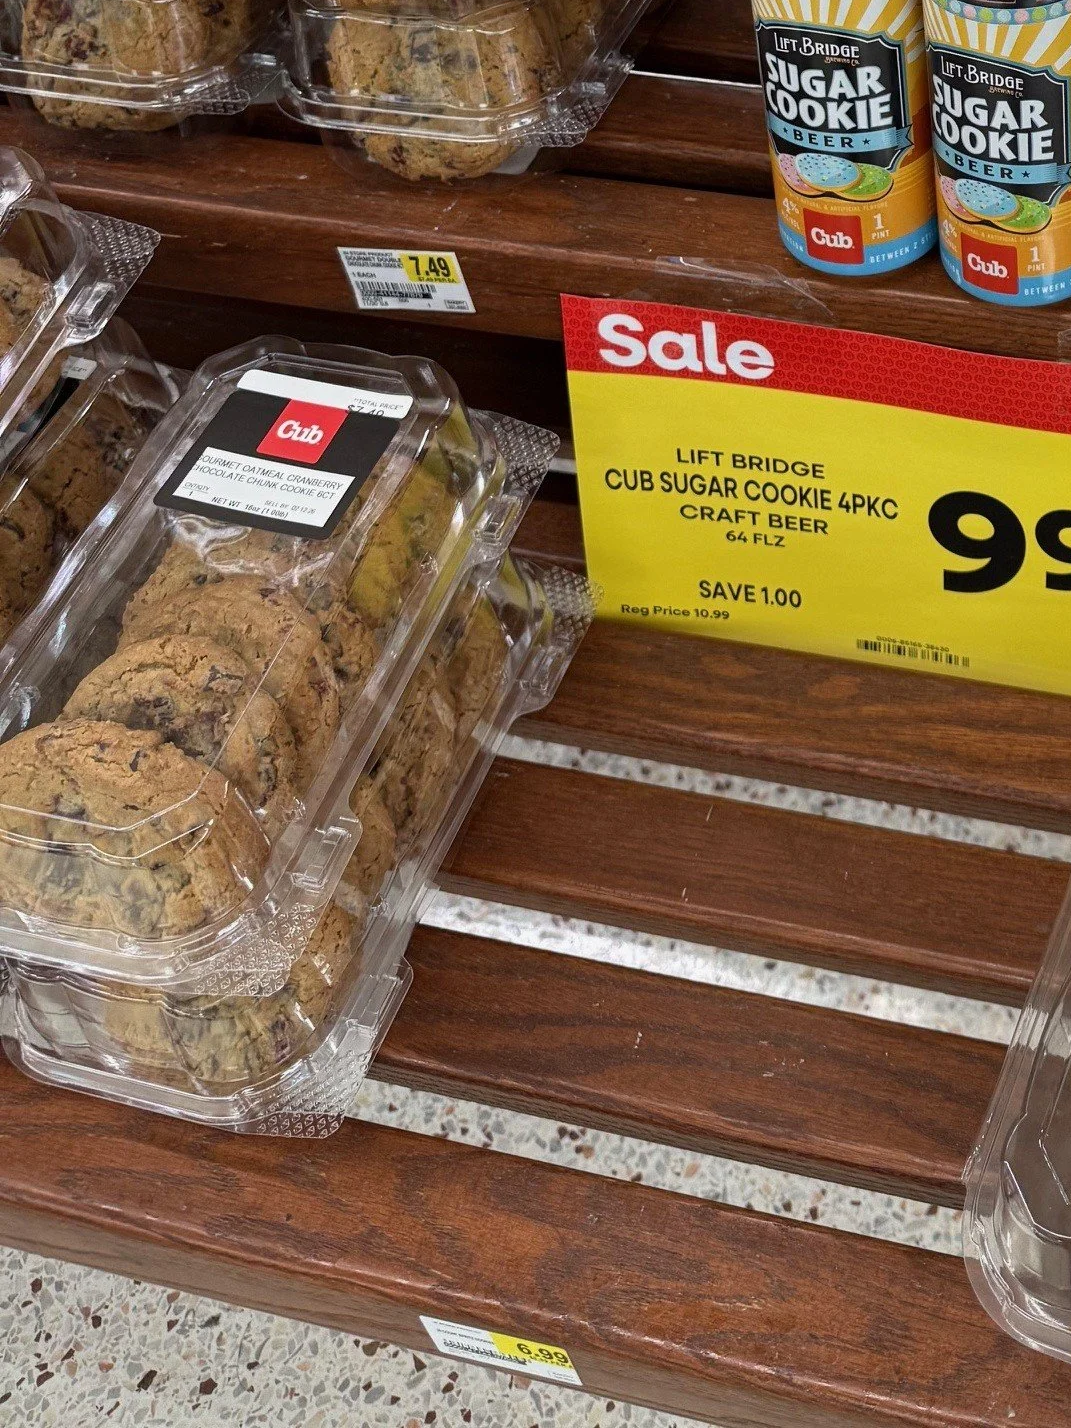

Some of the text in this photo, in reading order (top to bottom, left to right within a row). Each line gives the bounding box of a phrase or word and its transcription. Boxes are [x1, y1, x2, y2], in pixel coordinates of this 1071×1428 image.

[774, 32, 860, 58] LIFT BRIDGE
[765, 51, 886, 100] SUGAR
[940, 56, 1024, 91] LIFT BRIDGE
[766, 80, 893, 130] COOKIE
[932, 74, 1048, 130] SUGAR
[794, 129, 855, 149] BEER
[932, 104, 1054, 162] COOKIE
[955, 156, 1013, 180] BEER
[873, 213, 885, 230] 1
[811, 227, 853, 249] Cub
[871, 230, 890, 240] PINT
[870, 248, 910, 263] BETWEEN
[967, 252, 1008, 279] Cub
[1029, 246, 1040, 262] 1
[409, 256, 451, 277] 7.49
[1027, 263, 1046, 272] PINT
[1024, 283, 1065, 296] BETWEEN
[597, 313, 775, 380] Sale
[277, 419, 323, 445] Cub
[676, 448, 825, 479] LIFT BRIDGE
[242, 465, 285, 479] OATMEAL
[287, 474, 343, 490] CRANBERRY
[247, 477, 280, 489] CHUNK
[280, 483, 316, 496] COOKIE
[317, 490, 336, 500] 6CT
[211, 496, 227, 506] NET
[245, 504, 260, 513] 16oz
[605, 468, 899, 520] CUB SUGAR COOKIE 4PKC
[680, 504, 829, 535] CRAFT BEER
[726, 530, 786, 547] 64 FLZ
[699, 580, 802, 608] SAVE 1.00
[621, 604, 730, 620] Reg Price 10.99
[517, 1343, 568, 1363] 6.99
